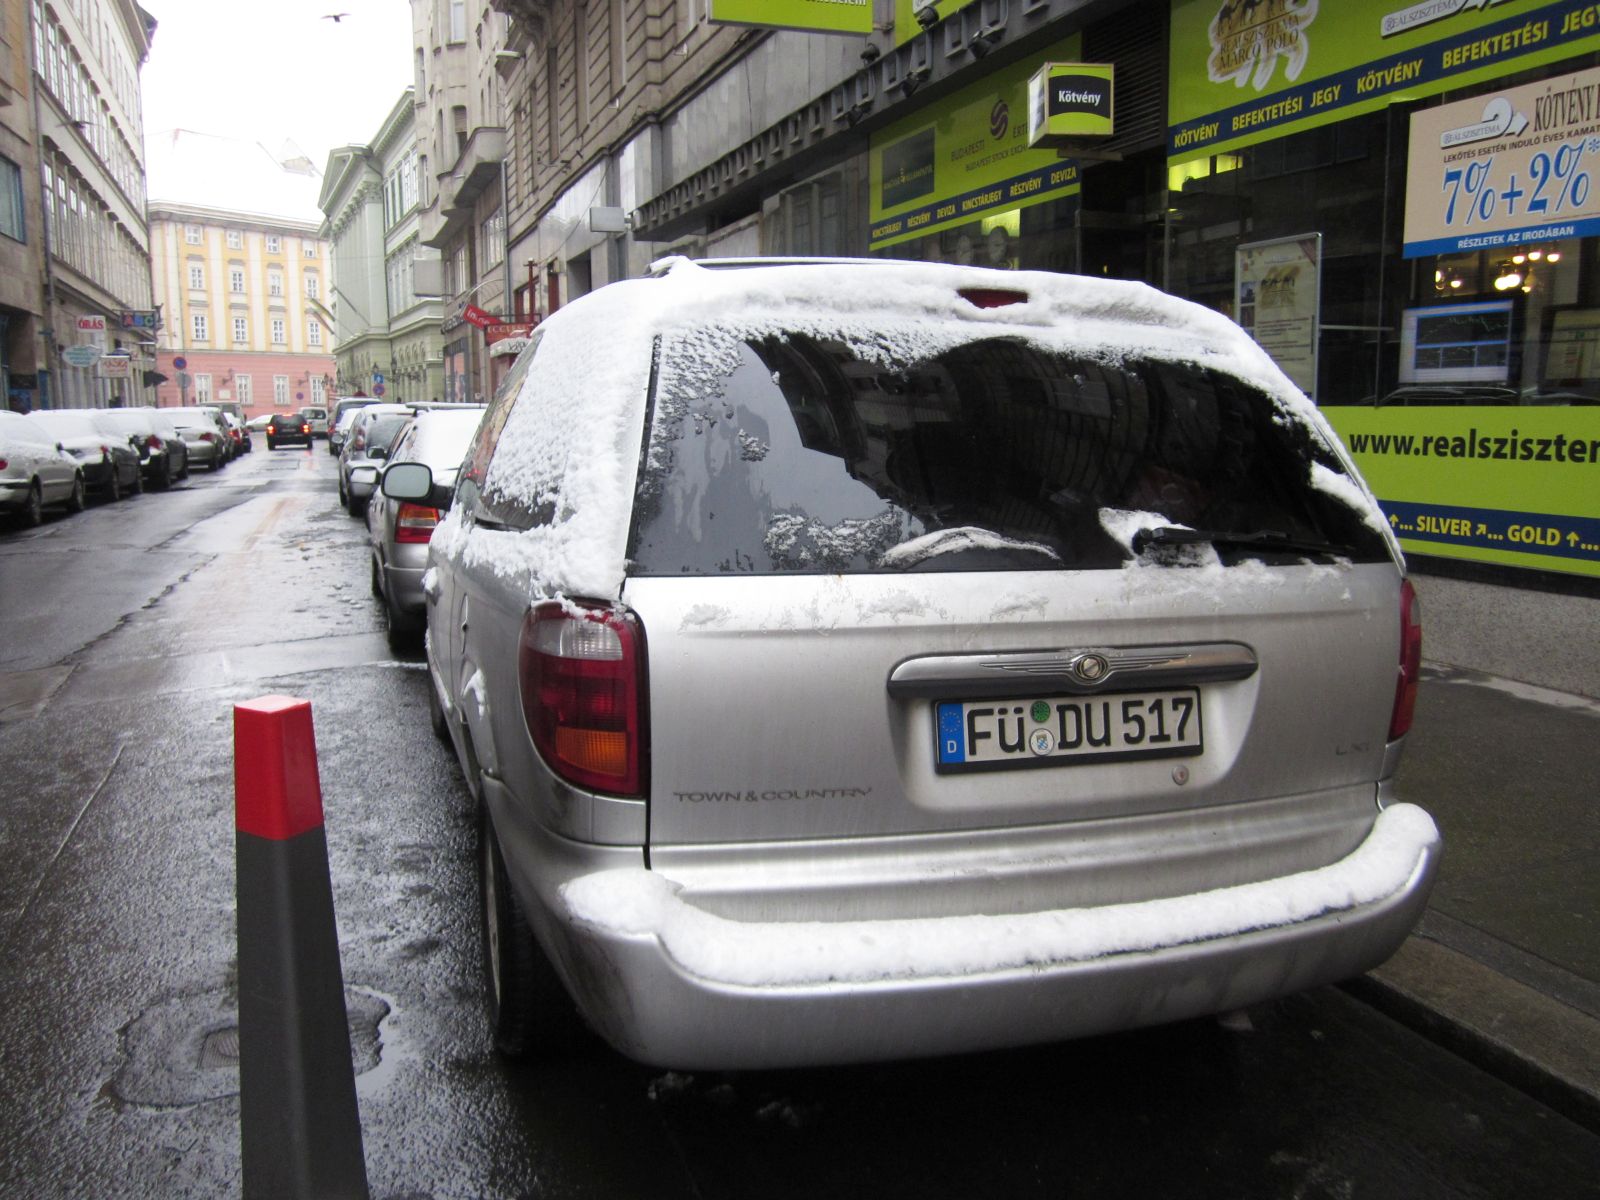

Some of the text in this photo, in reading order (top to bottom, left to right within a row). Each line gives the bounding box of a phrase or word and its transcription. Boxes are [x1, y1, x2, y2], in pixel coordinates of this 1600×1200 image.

[1220, 28, 1299, 69] MARCO POLO
[1058, 90, 1101, 107] Kötvény
[1174, 122, 1219, 149] KÖTVÉNY
[1232, 96, 1303, 131] BEFEKTETÉSI
[1310, 85, 1342, 108] JEGY
[1356, 58, 1424, 94] KÖTVÉNY
[1442, 20, 1549, 69] BEFEKTETÉSI
[1477, 143, 1506, 157] ESETÉN
[1509, 136, 1541, 151] INDULÓ
[1543, 131, 1564, 144] ÉVES
[937, 204, 956, 219] DEVIZA
[962, 190, 1003, 211] KINCSTÁRJEGY
[1010, 177, 1042, 196] RÉSZVÉNY
[1051, 166, 1077, 185] DEVIZA
[1457, 226, 1575, 249] RÉSZLETEK AZ IRODÁBAN
[1416, 515, 1561, 546] SILVER GOLD
[967, 697, 1194, 756] FÜ DU 517
[947, 740, 957, 754] D
